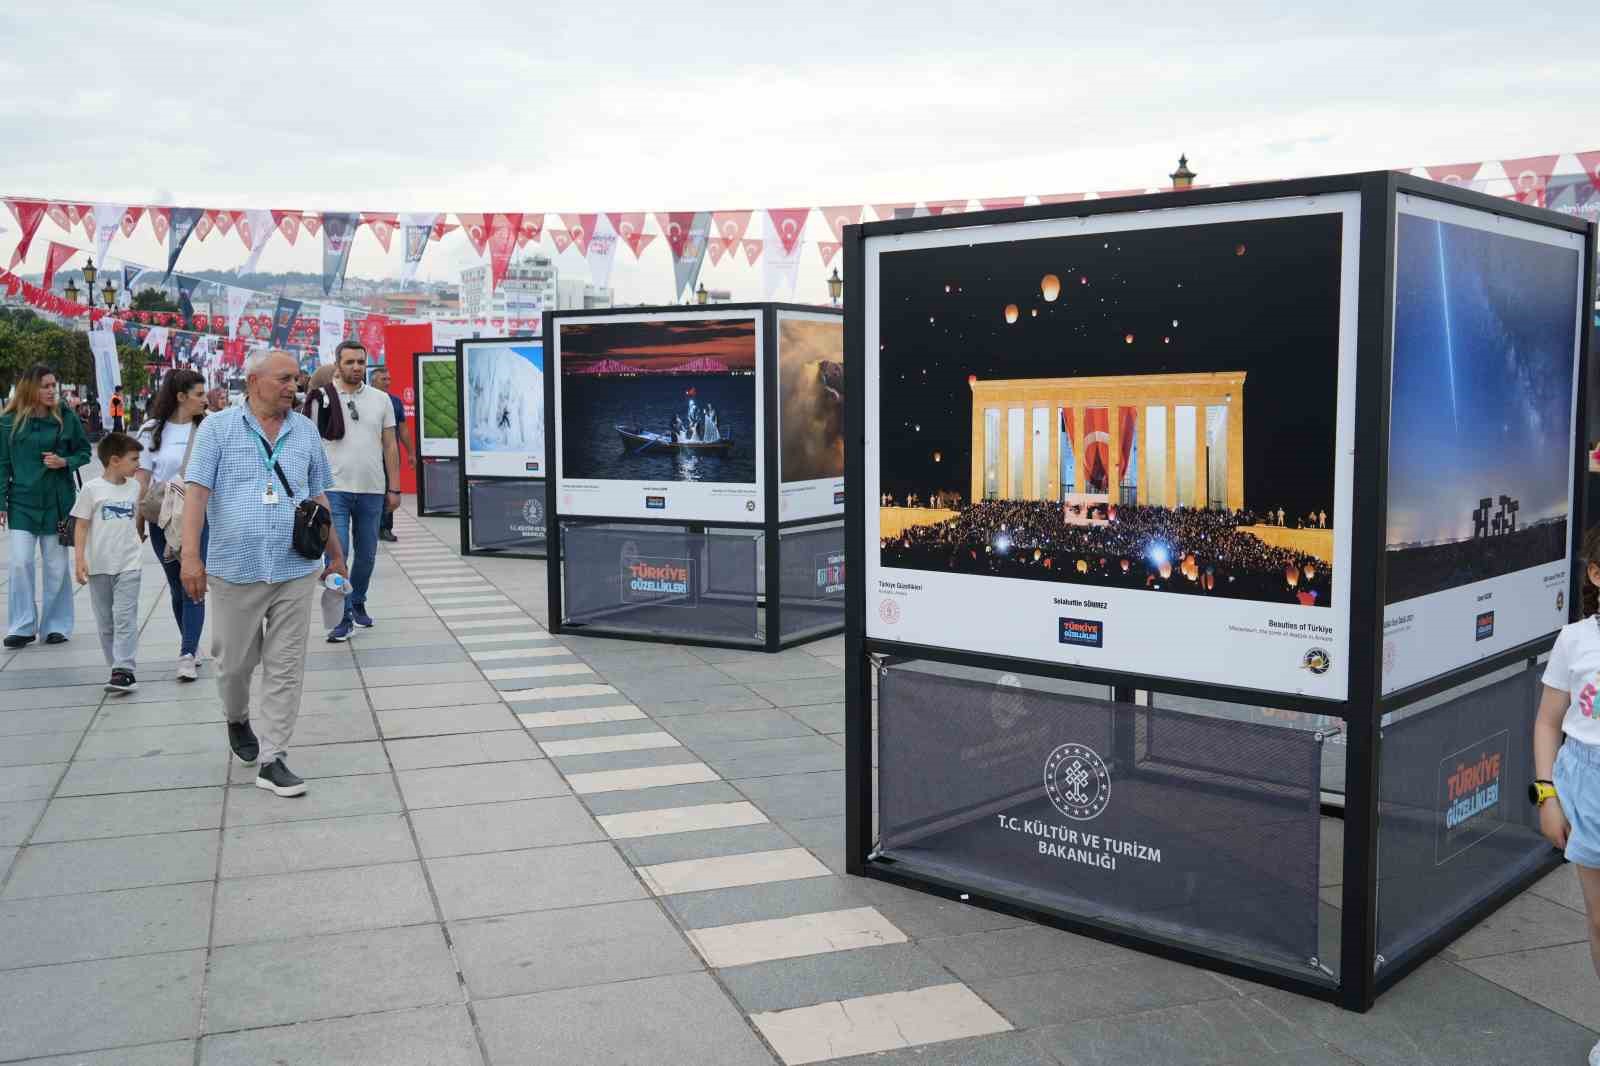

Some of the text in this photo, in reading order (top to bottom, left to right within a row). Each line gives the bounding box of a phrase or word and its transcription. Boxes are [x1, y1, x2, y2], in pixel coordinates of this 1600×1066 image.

[630, 562, 688, 581] TÜRKİYE
[631, 577, 688, 593] GÜZELLİKLERİ
[1063, 622, 1098, 633] TÜRKİYE
[1268, 620, 1298, 630] Beauties
[1308, 624, 1332, 634] Türkiye
[1447, 752, 1501, 800] TÜRKİYE
[1446, 776, 1499, 829] GÜZELLİKLERİ
[998, 814, 1161, 863] T.C. KÜLTÜR VE TURİZM
[1038, 840, 1116, 870] BAKANLIĞI
